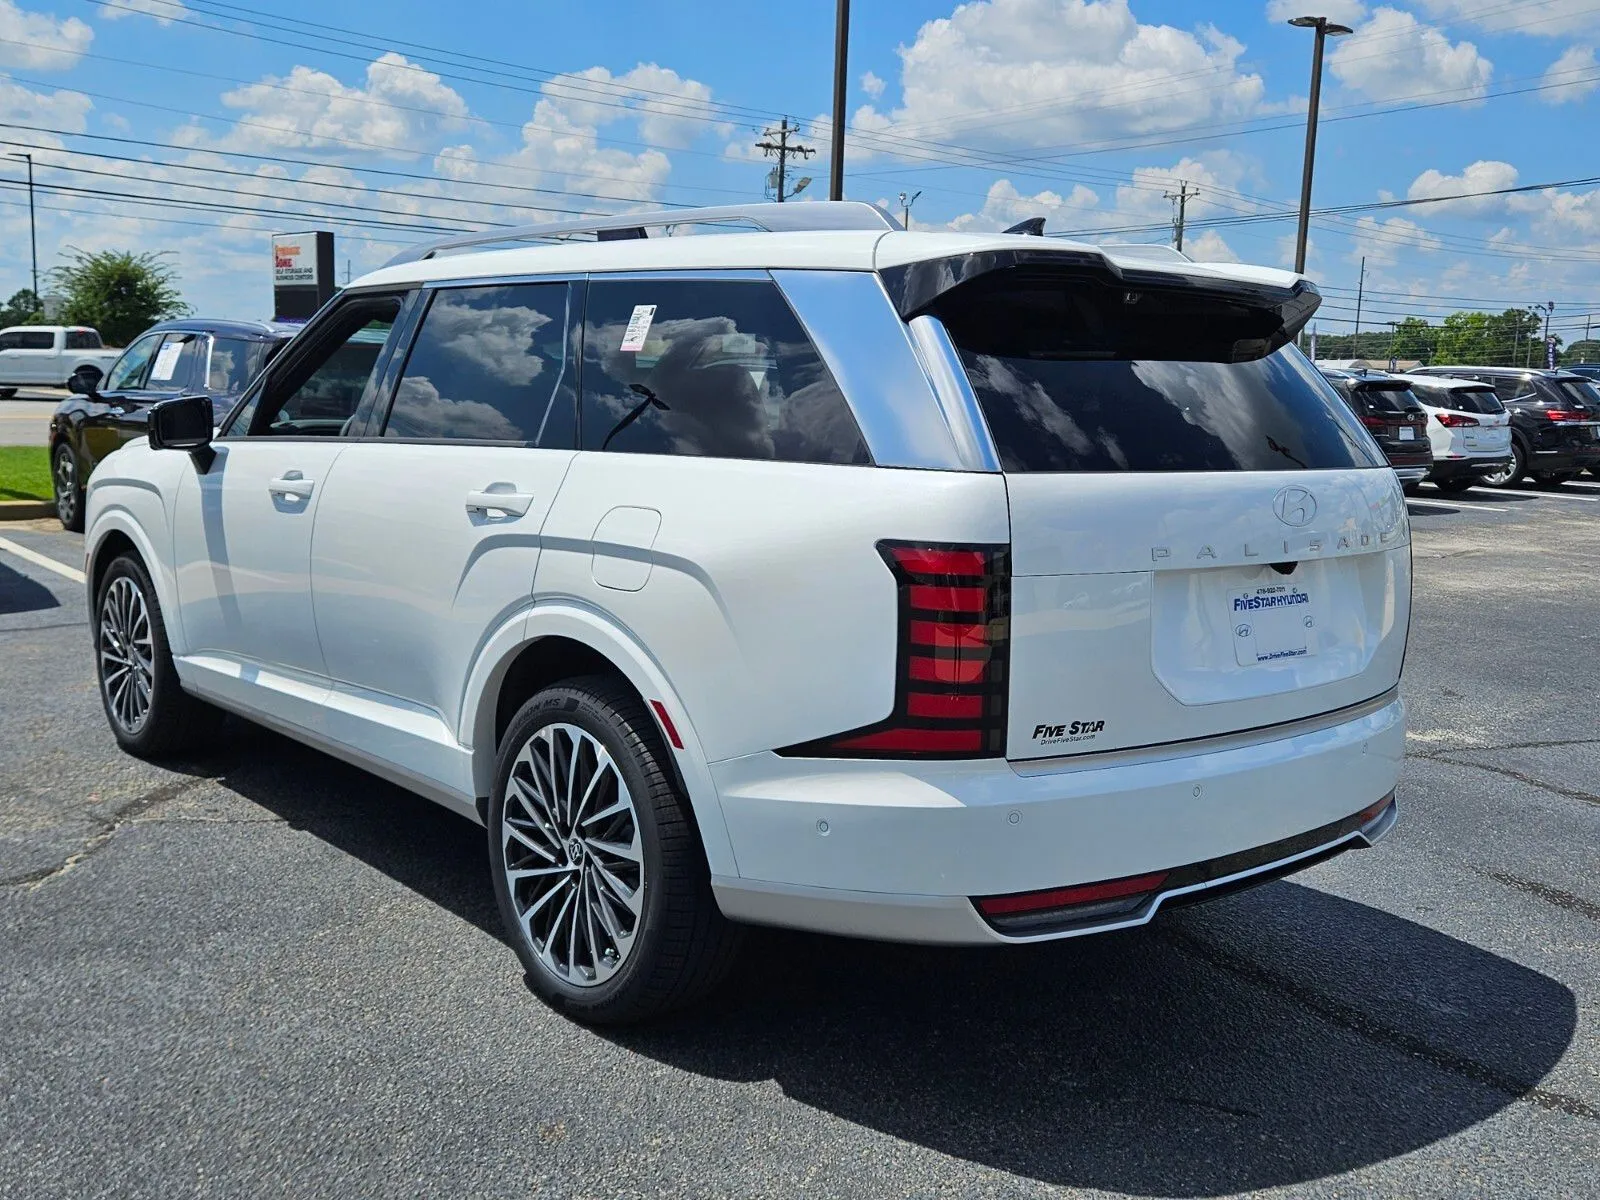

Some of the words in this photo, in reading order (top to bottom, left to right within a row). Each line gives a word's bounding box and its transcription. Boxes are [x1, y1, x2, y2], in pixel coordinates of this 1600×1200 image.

[1151, 532, 1391, 562] PALISADE
[1032, 724, 1067, 740] FIVE
[1068, 720, 1105, 736] STAR
[1040, 734, 1096, 746] DriveFiveStar.com
